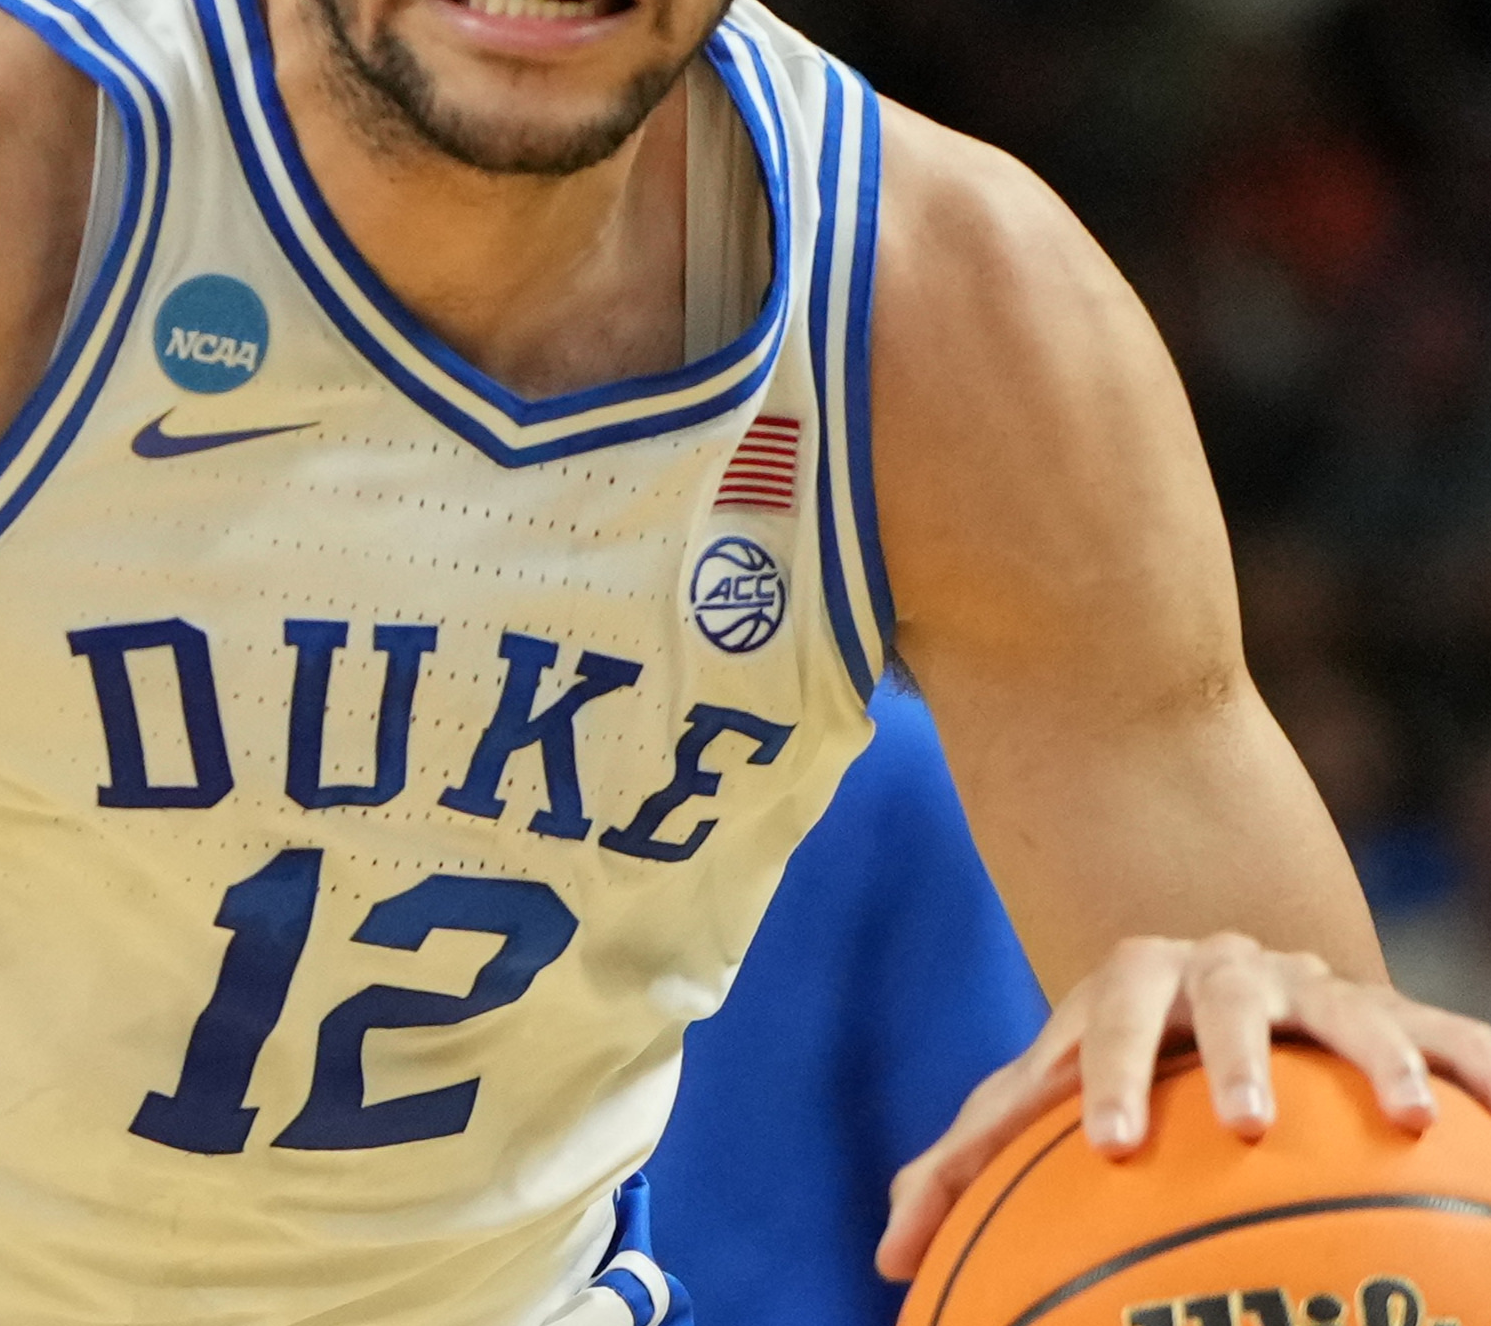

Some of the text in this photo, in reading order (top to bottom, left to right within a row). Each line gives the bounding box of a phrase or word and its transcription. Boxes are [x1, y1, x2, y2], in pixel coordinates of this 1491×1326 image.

[164, 325, 259, 373] NCAA
[703, 571, 779, 602] ACC
[67, 616, 796, 863] DUKE
[127, 847, 581, 1155] 12
